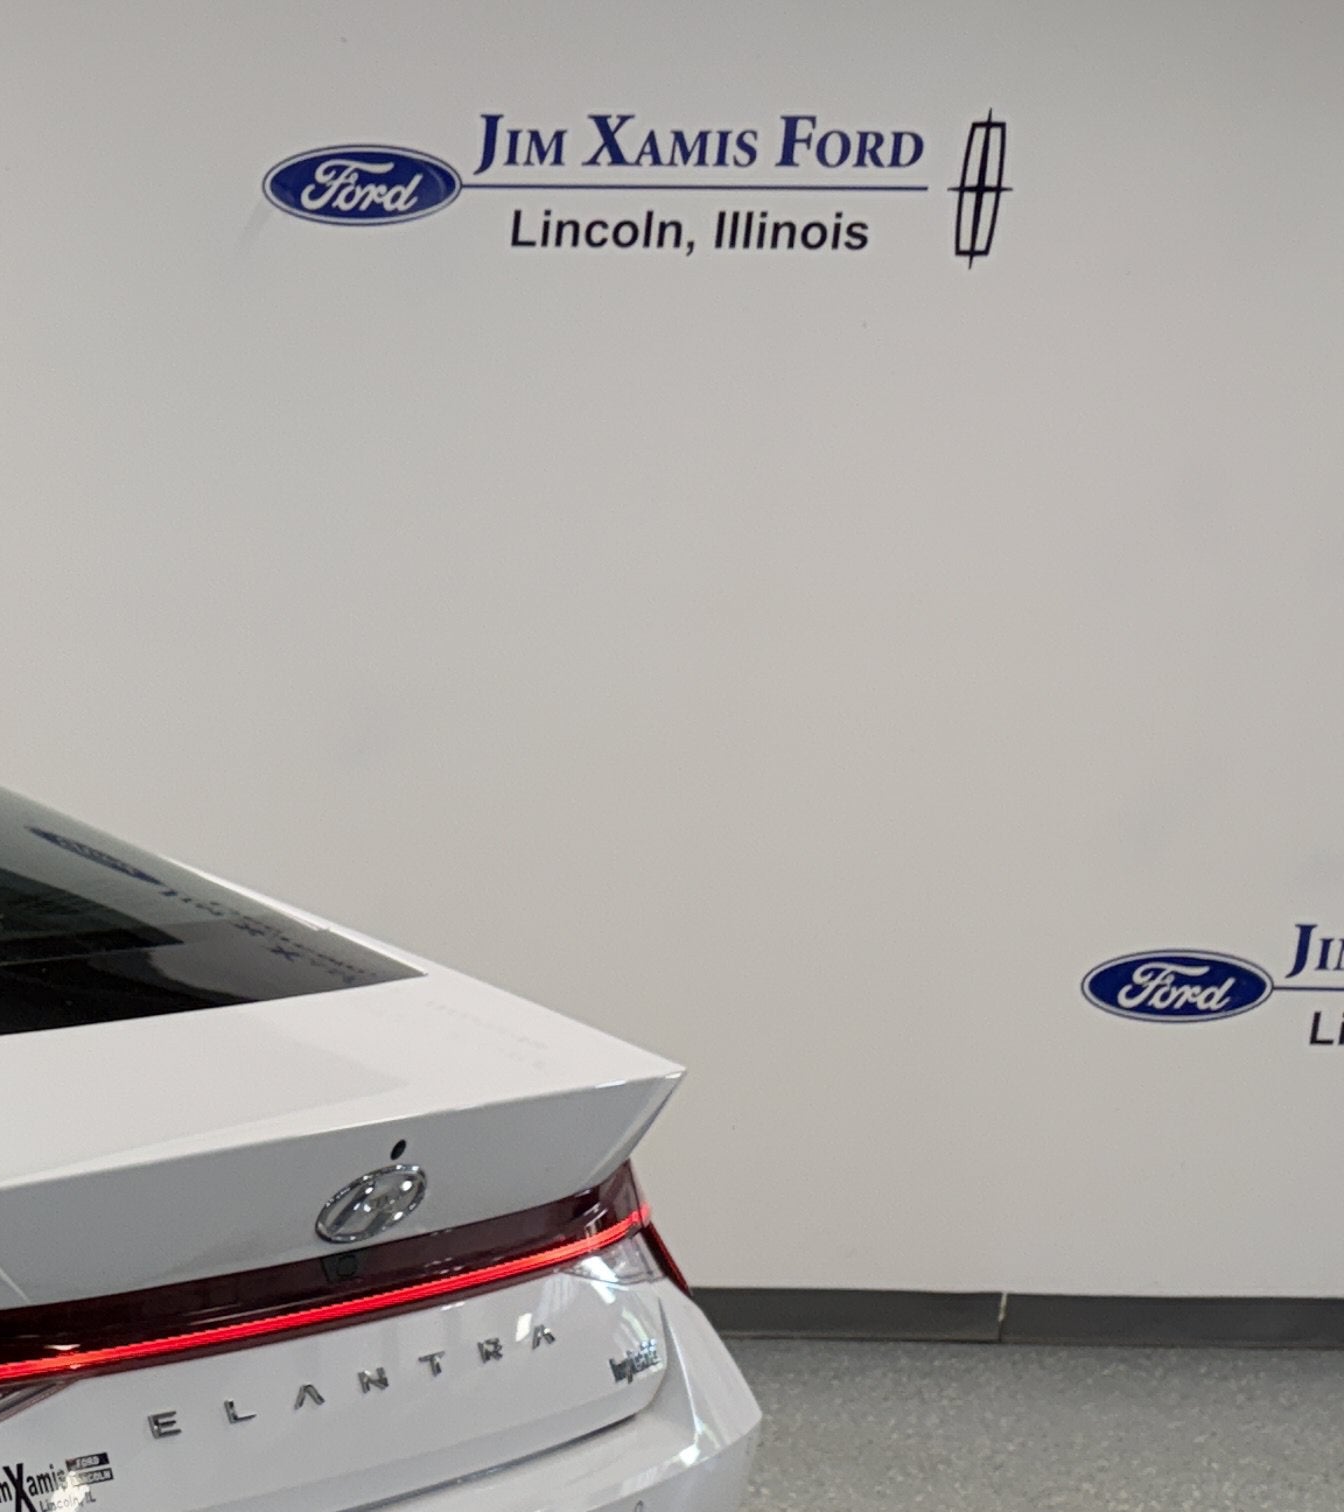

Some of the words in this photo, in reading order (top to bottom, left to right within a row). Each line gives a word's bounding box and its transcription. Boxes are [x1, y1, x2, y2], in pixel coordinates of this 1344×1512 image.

[300, 159, 424, 212] Ford
[511, 209, 695, 257] Lincoln,
[714, 211, 869, 250] Illinois
[1117, 962, 1236, 1010] Ford
[148, 1324, 555, 1439] ELANTRA
